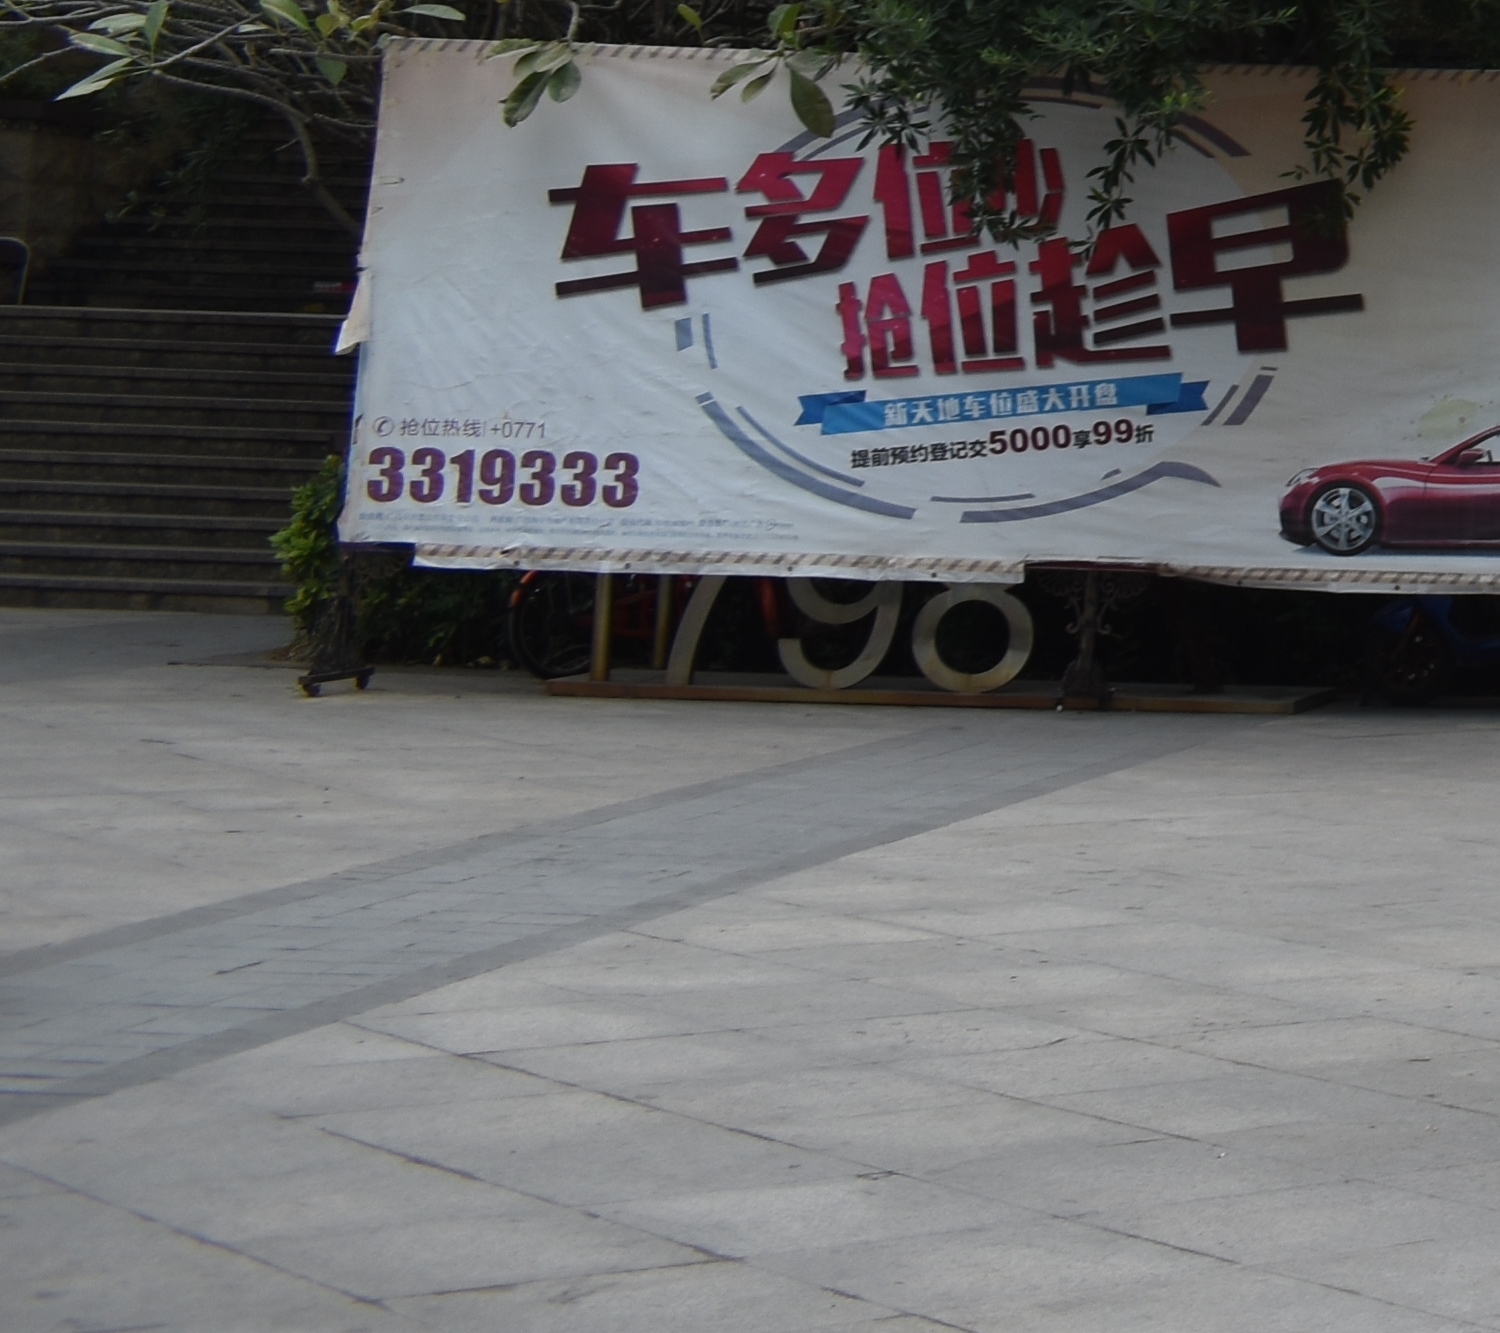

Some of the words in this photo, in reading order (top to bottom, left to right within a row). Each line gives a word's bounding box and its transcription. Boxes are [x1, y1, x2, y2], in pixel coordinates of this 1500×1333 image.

[882, 380, 1119, 427] 新天地车位盛大开盘
[850, 417, 1155, 470] 提前预约登记交5000享99折
[366, 446, 641, 509] 3319333
